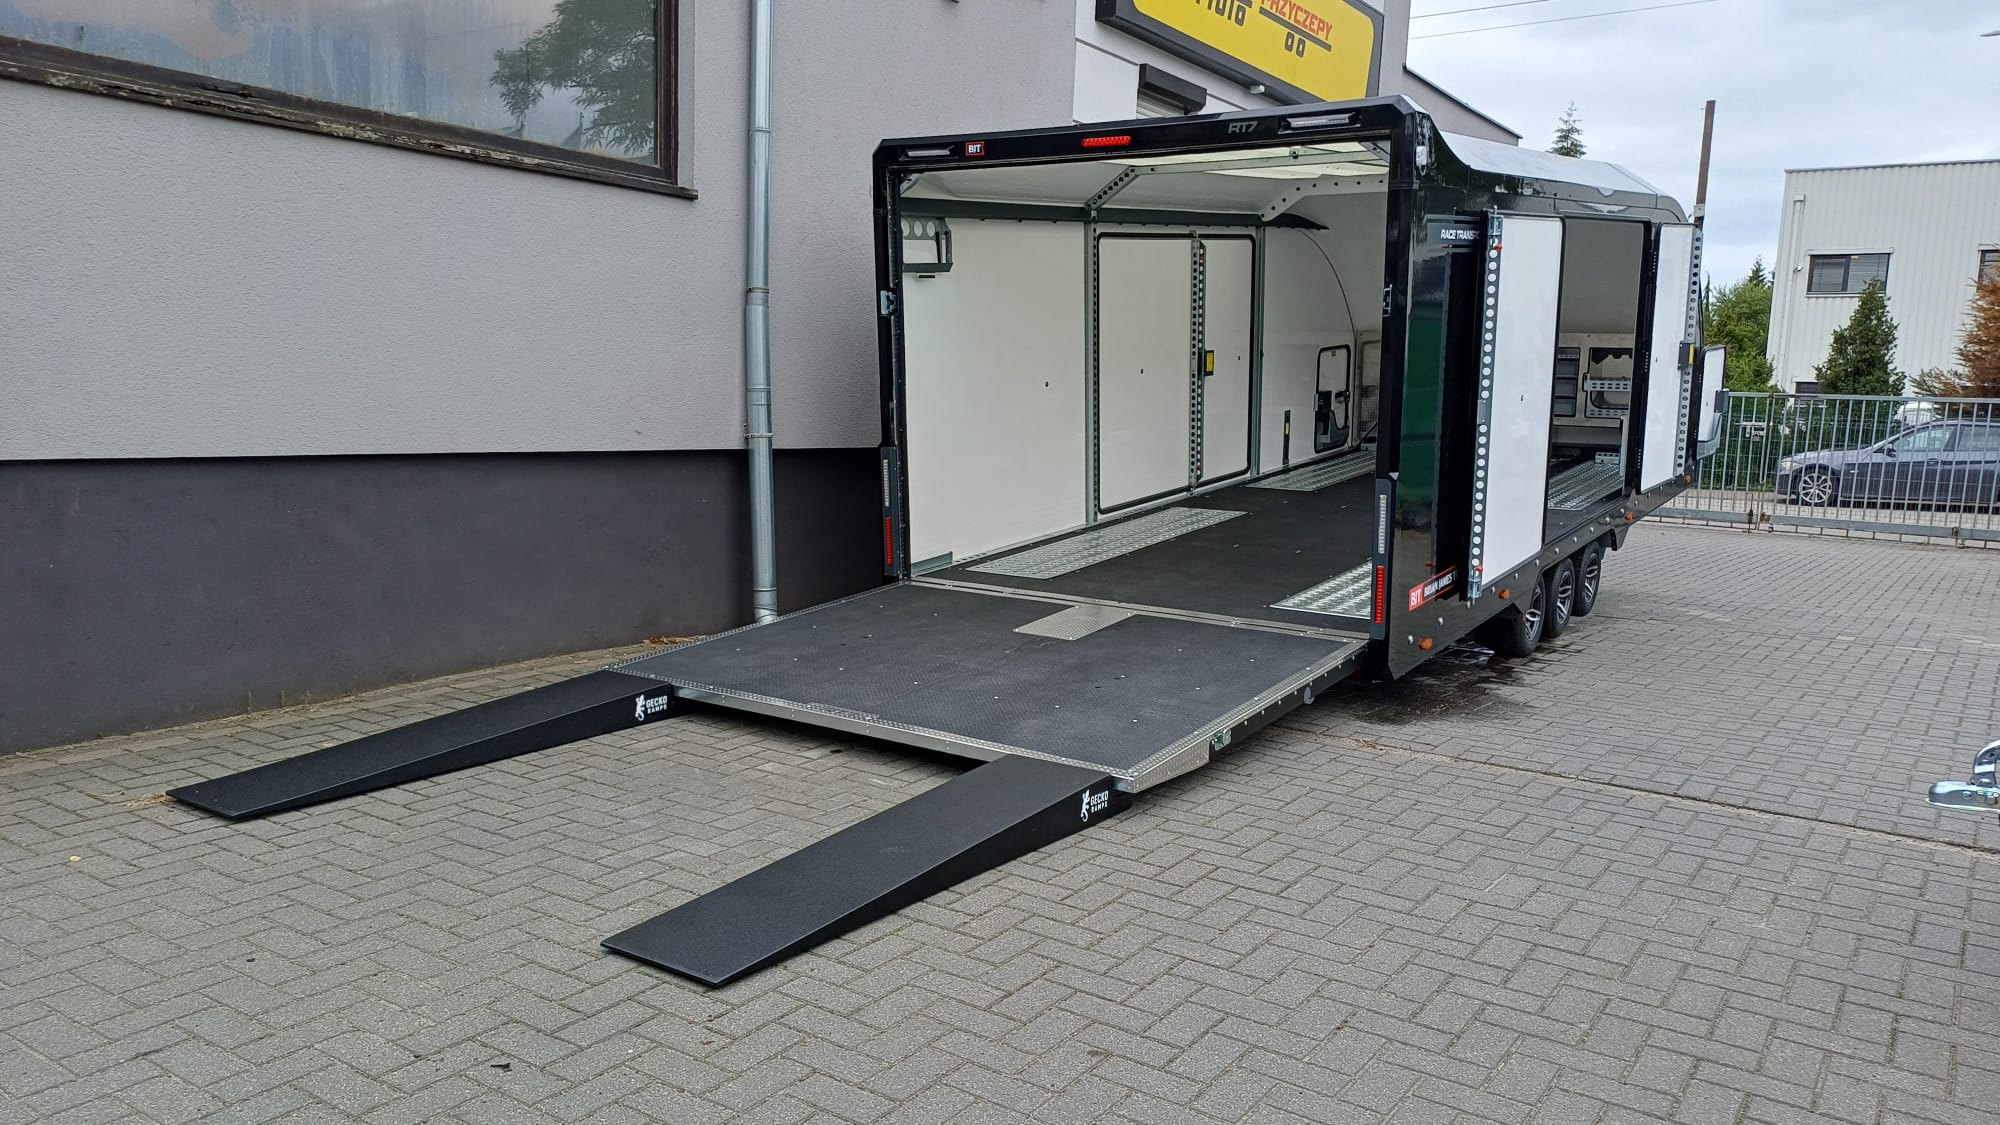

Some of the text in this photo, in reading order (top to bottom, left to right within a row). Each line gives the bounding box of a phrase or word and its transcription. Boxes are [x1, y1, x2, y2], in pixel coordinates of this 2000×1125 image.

[1228, 121, 1258, 134] RT7
[1440, 229, 1456, 240] RACE
[646, 695, 668, 708] GECKO
[1090, 790, 1109, 806] GECKO
